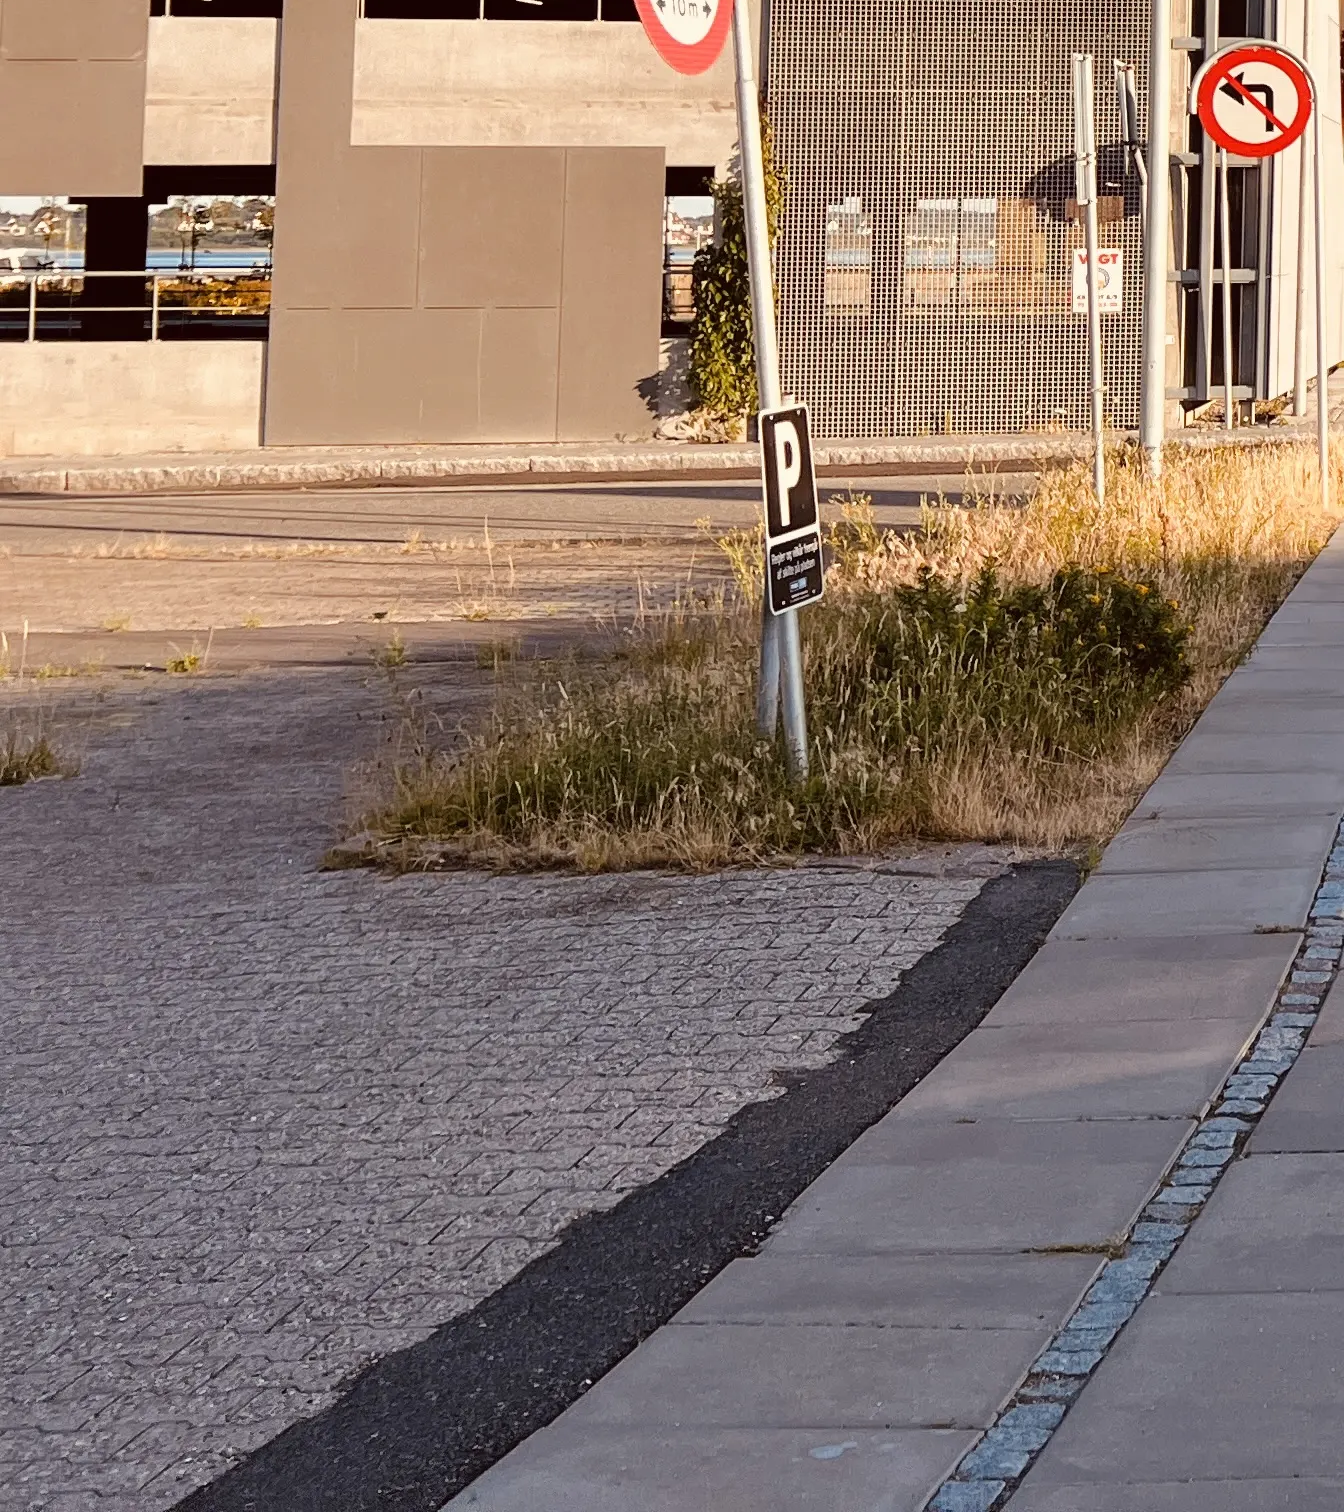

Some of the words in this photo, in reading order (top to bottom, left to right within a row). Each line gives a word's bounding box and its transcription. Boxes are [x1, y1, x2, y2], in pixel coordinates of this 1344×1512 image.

[689, 3, 698, 16] m
[1078, 253, 1118, 264] VGT
[774, 420, 801, 526] P
